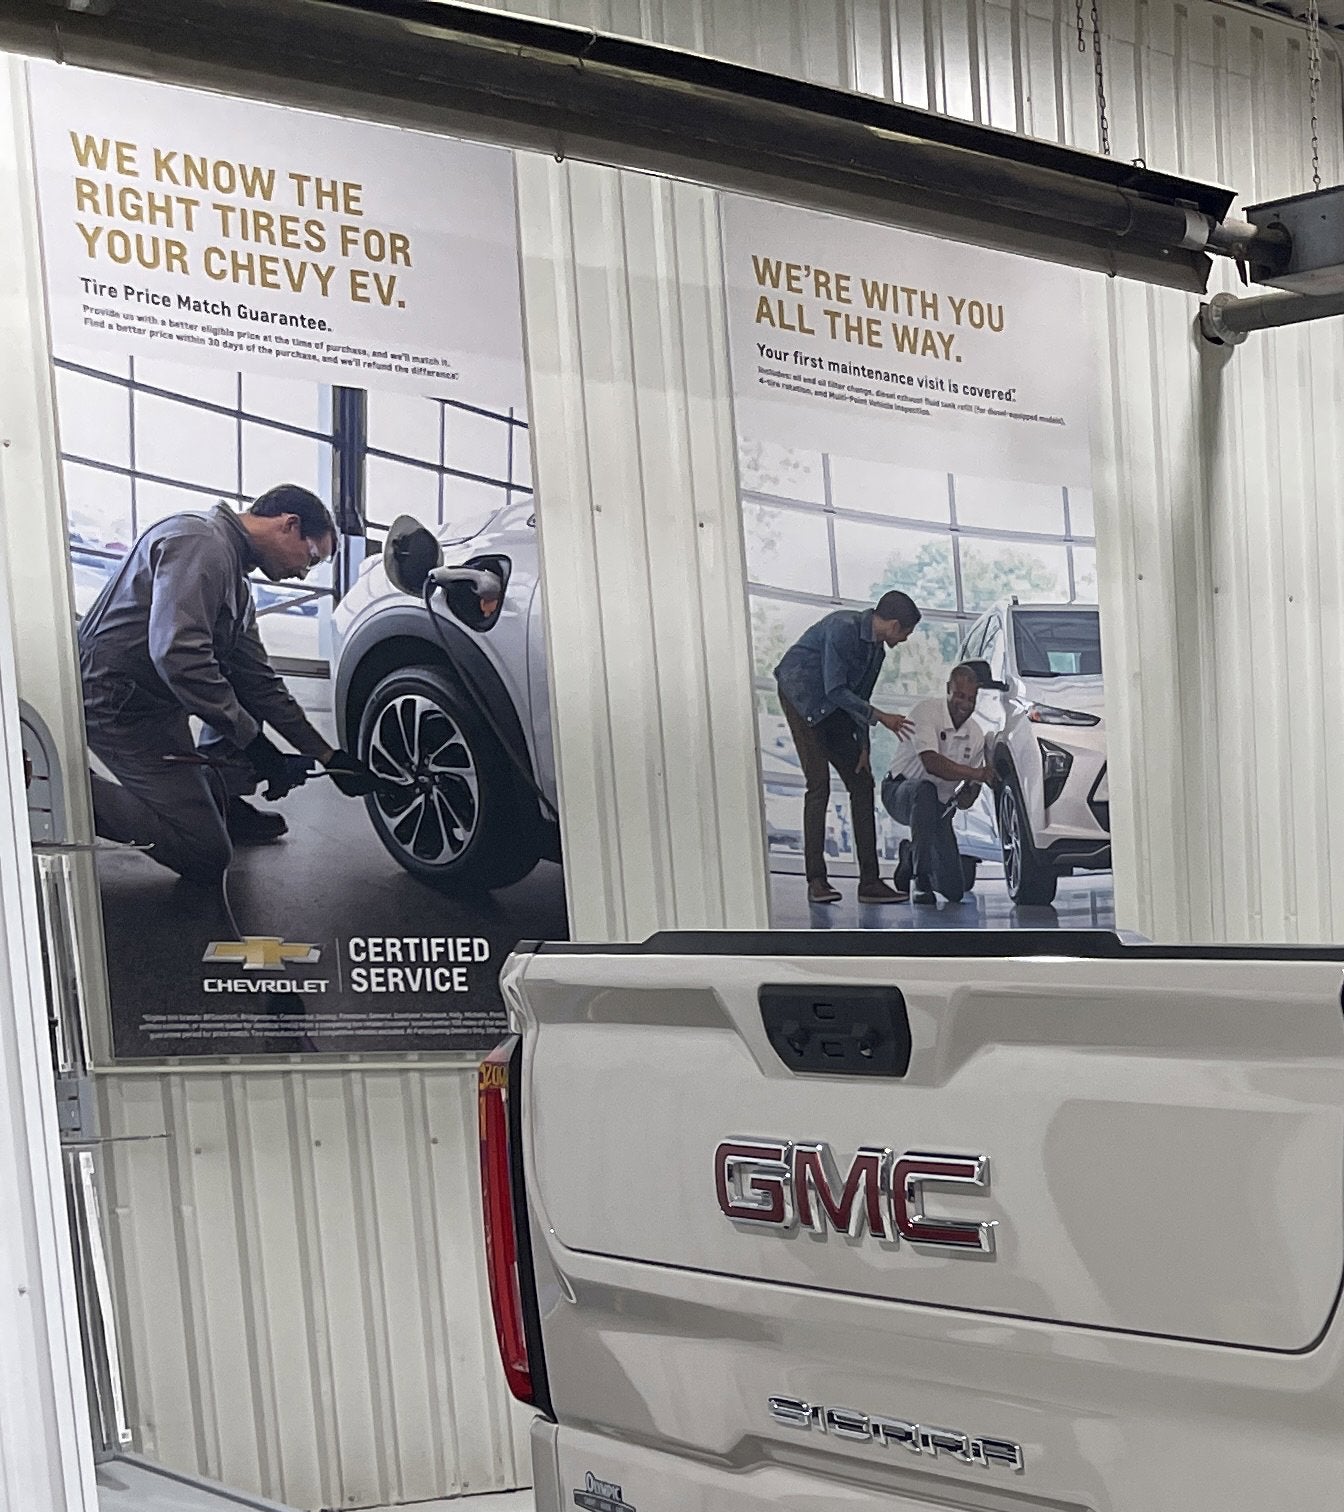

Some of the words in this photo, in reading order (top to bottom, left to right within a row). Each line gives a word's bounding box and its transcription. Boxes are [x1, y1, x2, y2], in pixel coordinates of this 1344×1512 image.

[69, 131, 139, 177] WE
[152, 149, 276, 201] KNOW
[289, 172, 364, 217] THE
[74, 177, 200, 232] RIGHT
[212, 204, 327, 253] TIRES
[340, 226, 413, 267] FOR
[75, 222, 191, 275] YOUR
[203, 246, 336, 297] CHEVY
[350, 270, 406, 308] EV.
[751, 255, 852, 304] WE'RE
[860, 278, 939, 321] WITH
[947, 295, 1005, 332] YOU
[80, 277, 118, 298] Tire
[124, 284, 171, 308] Price
[177, 294, 232, 318] Match
[237, 303, 332, 331] Guarantee.
[82, 304, 121, 319] Provide
[123, 313, 135, 321] us
[137, 314, 158, 325] with
[169, 319, 198, 332] better
[201, 325, 234, 337] eligible
[237, 330, 260, 342] price
[274, 336, 290, 346] the
[292, 338, 312, 349] time
[314, 341, 324, 350] of
[372, 350, 388, 359] and
[412, 354, 440, 366] match
[755, 295, 815, 335] ALL
[823, 308, 883, 348] THE
[892, 322, 962, 363] WAY.
[84, 317, 105, 329] Find
[108, 322, 114, 330] a
[116, 322, 147, 335] better
[149, 329, 174, 341] price
[176, 333, 205, 345] within
[207, 337, 220, 347] 30
[222, 340, 244, 352] days
[246, 343, 256, 353] of
[258, 345, 273, 355] the
[322, 354, 338, 364] and
[363, 360, 392, 372] refund
[395, 364, 409, 374] the
[757, 342, 789, 362] Your
[793, 350, 824, 369] first
[828, 361, 914, 386] maintenance
[917, 375, 945, 391] visit
[948, 378, 959, 394] is
[348, 937, 490, 964] CERTIFIED
[350, 967, 469, 993] SERVICE
[203, 979, 329, 993] CHEVROLET
[714, 1136, 993, 1254] GMC
[768, 1396, 1024, 1474] SIERRA
